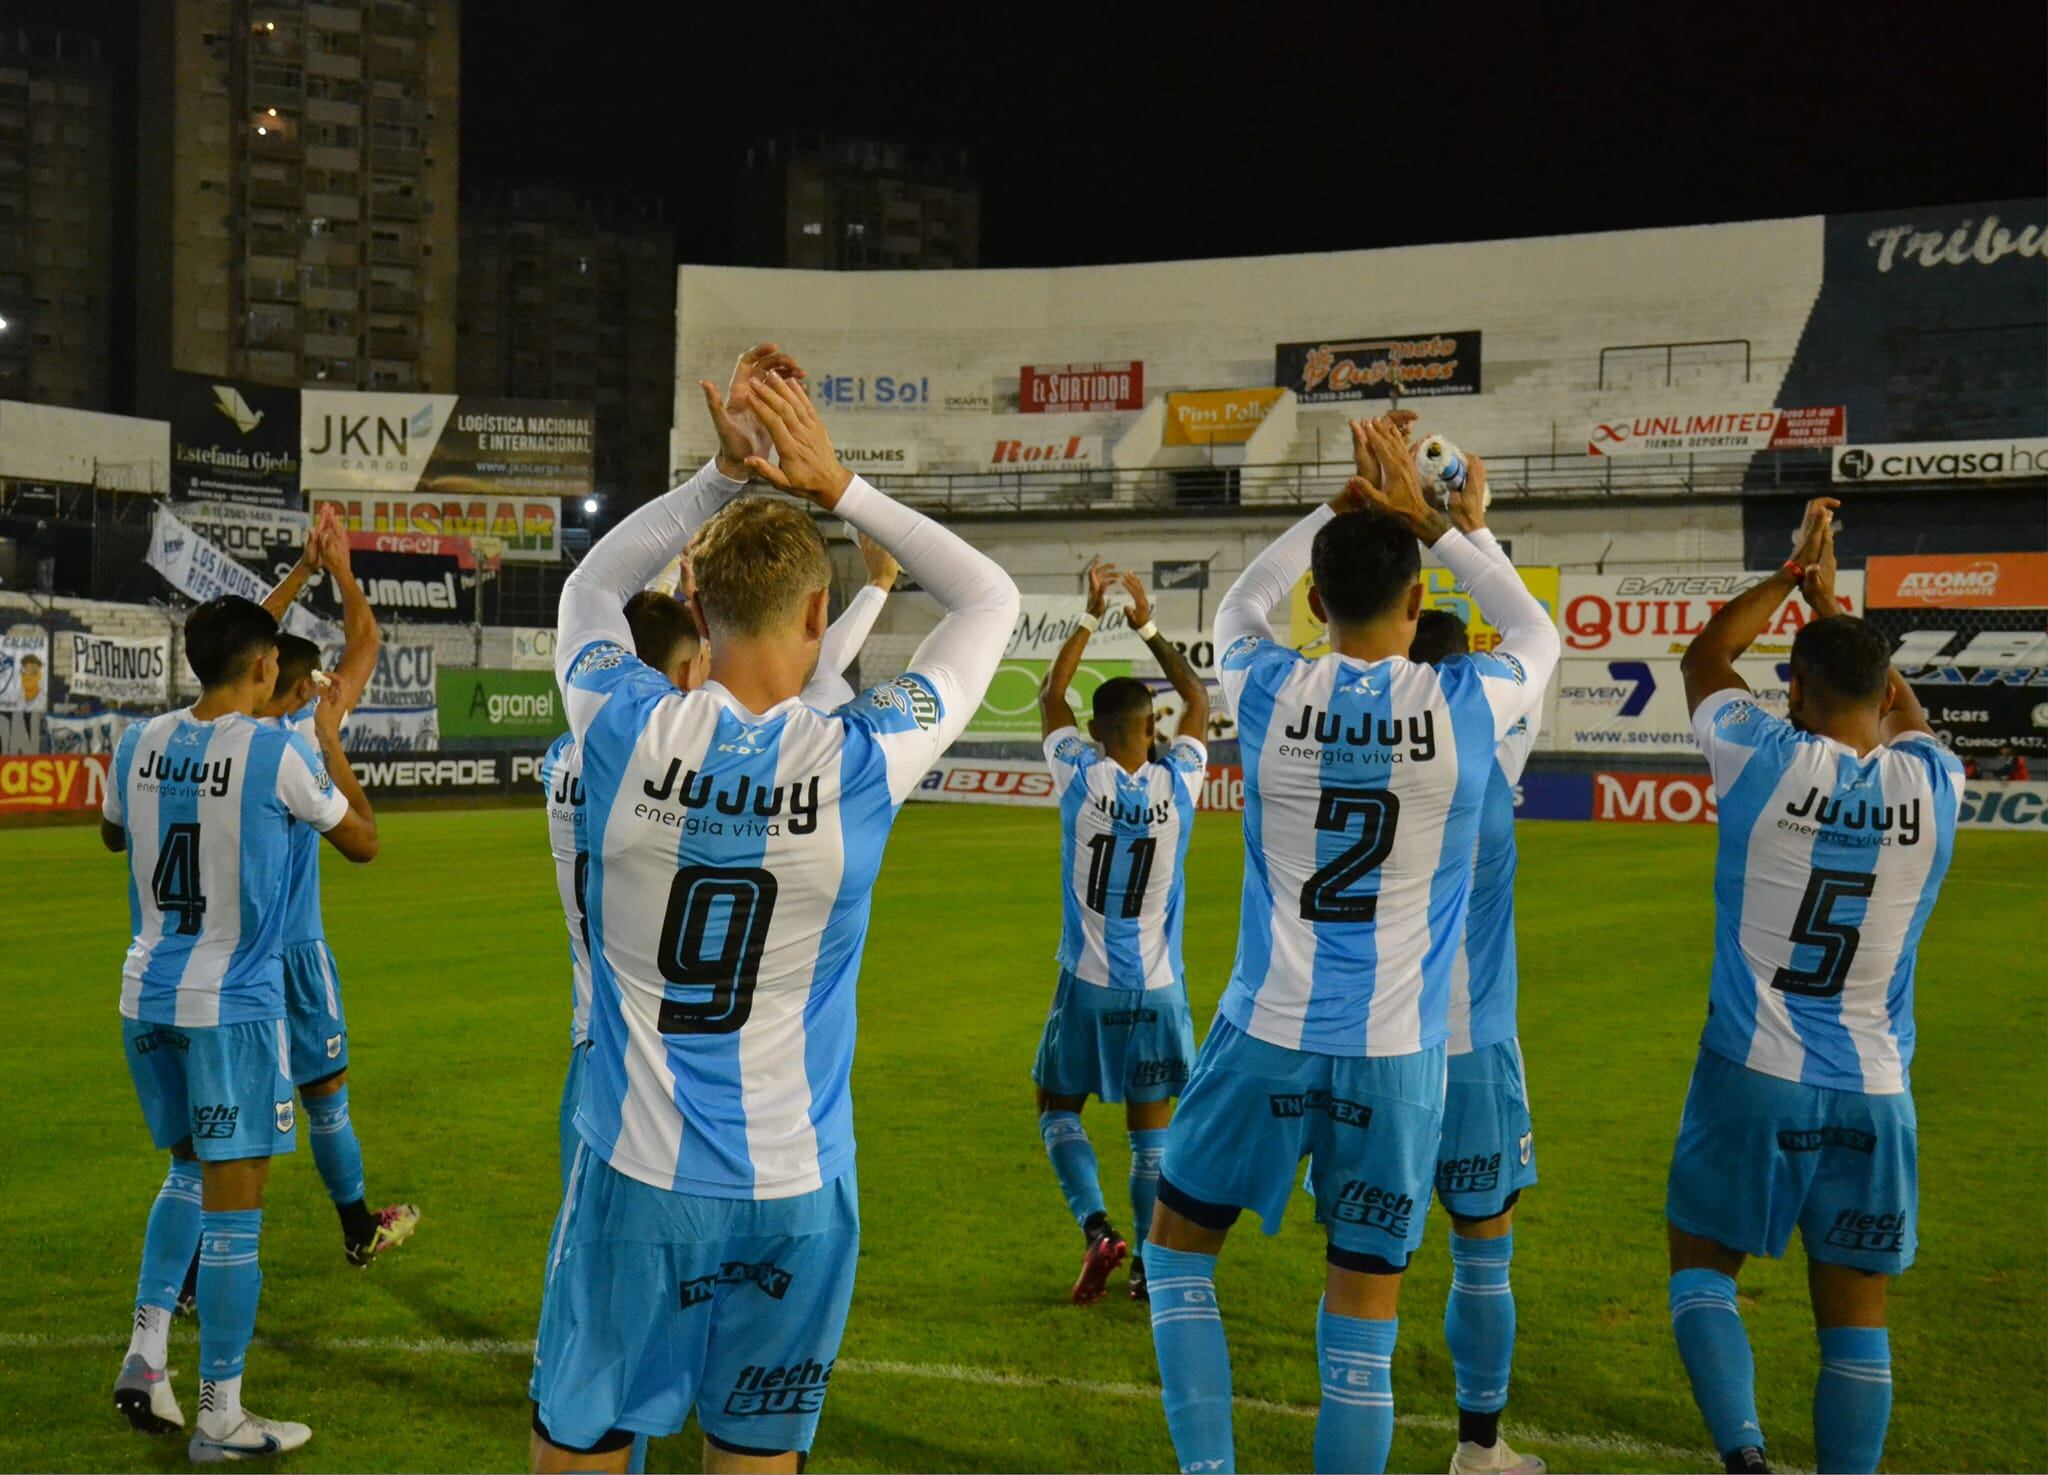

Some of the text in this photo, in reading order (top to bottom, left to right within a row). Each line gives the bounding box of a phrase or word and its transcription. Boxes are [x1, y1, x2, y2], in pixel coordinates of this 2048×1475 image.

[875, 376, 929, 403] Sol
[1032, 373, 1130, 404] EL SURTIDOR
[527, 416, 593, 436] NACIONAL
[1177, 404, 1218, 424] Pim
[1632, 412, 1777, 437] UNLIMITED
[309, 414, 408, 456] JKN
[478, 434, 592, 453] E INTERNACIONAL
[1644, 435, 1749, 450] TIENDA DEPORTIVA
[340, 459, 409, 472] CARGO
[191, 541, 258, 603] LOS INDIOS
[1902, 571, 1998, 588] ATOMO
[74, 634, 164, 680] PLATANOS
[1559, 686, 1627, 699] SEVEN
[1278, 743, 1404, 766] energía viva
[179, 786, 207, 798] viva
[634, 803, 781, 839] energía viva
[1299, 787, 1401, 923] 2
[152, 822, 207, 937] 4
[1087, 833, 1158, 920] 11
[1770, 867, 1877, 999] 5
[657, 865, 778, 1035] 9
[731, 1390, 826, 1414] BUS
